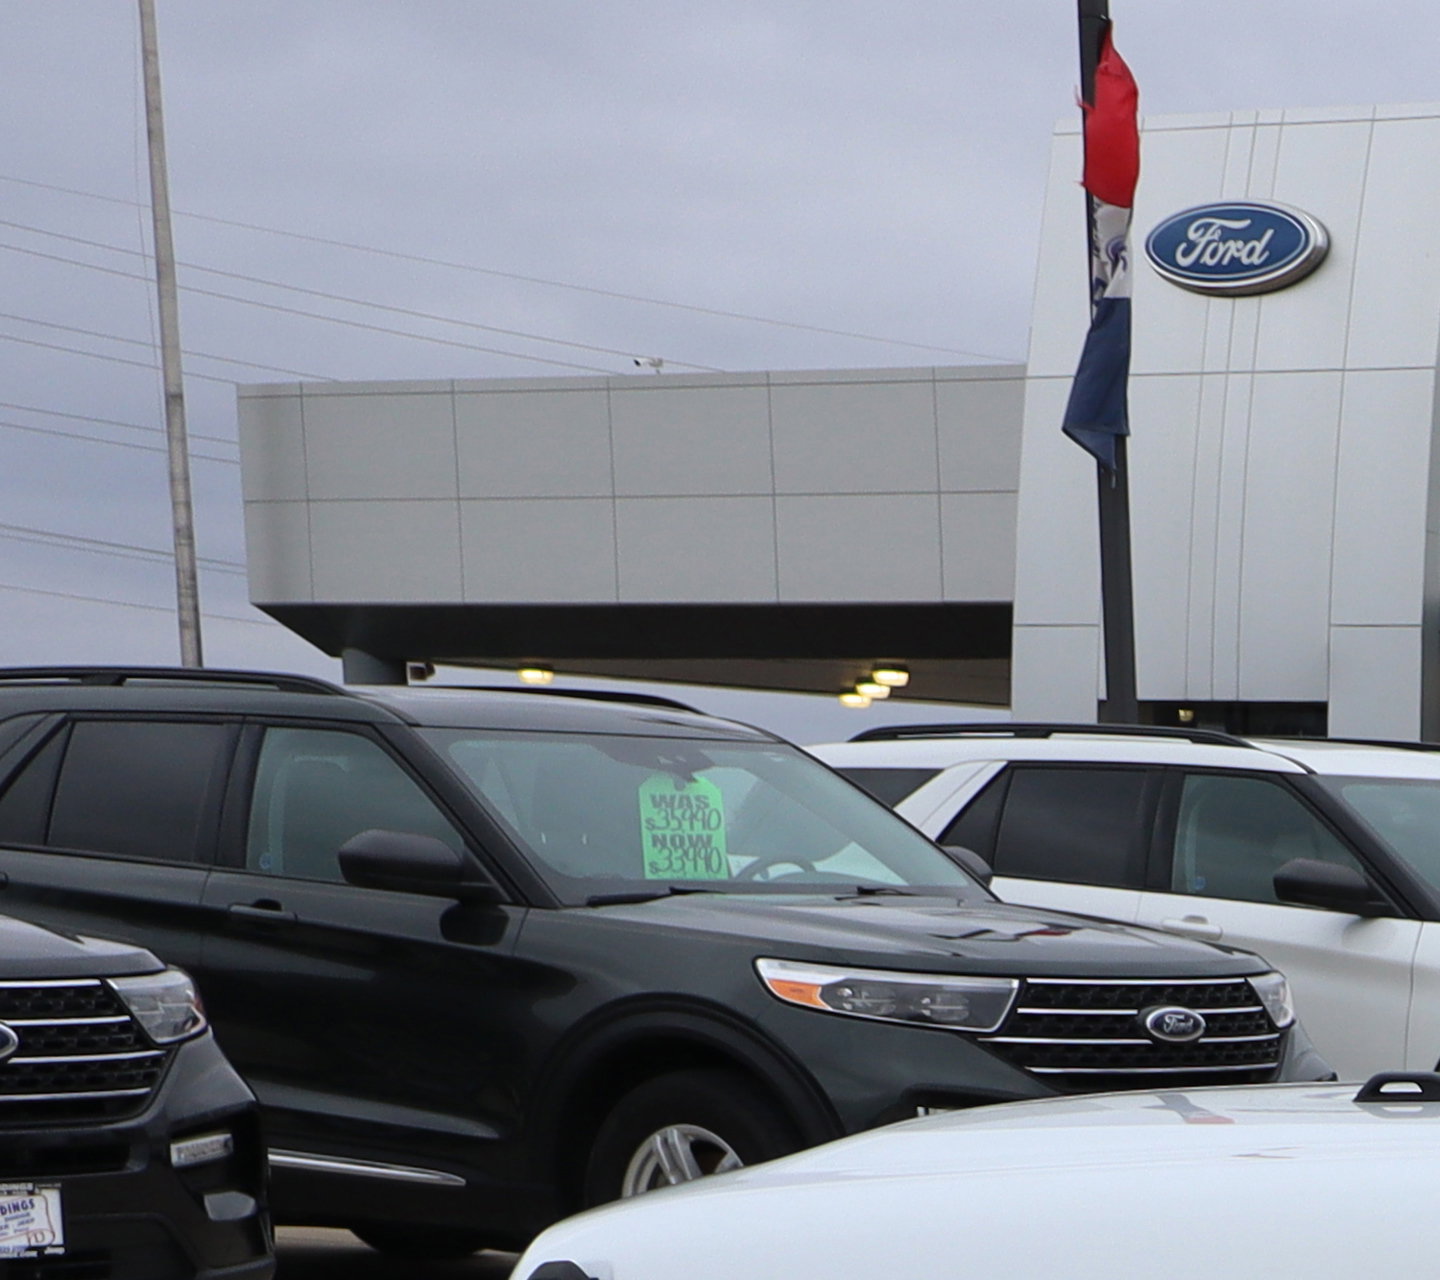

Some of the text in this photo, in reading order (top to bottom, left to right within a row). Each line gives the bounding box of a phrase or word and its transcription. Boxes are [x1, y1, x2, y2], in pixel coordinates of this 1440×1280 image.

[1175, 217, 1275, 267] Ford
[650, 795, 710, 809] WAS
[651, 834, 712, 848] NOW
[0, 1198, 35, 1215] DINGS
